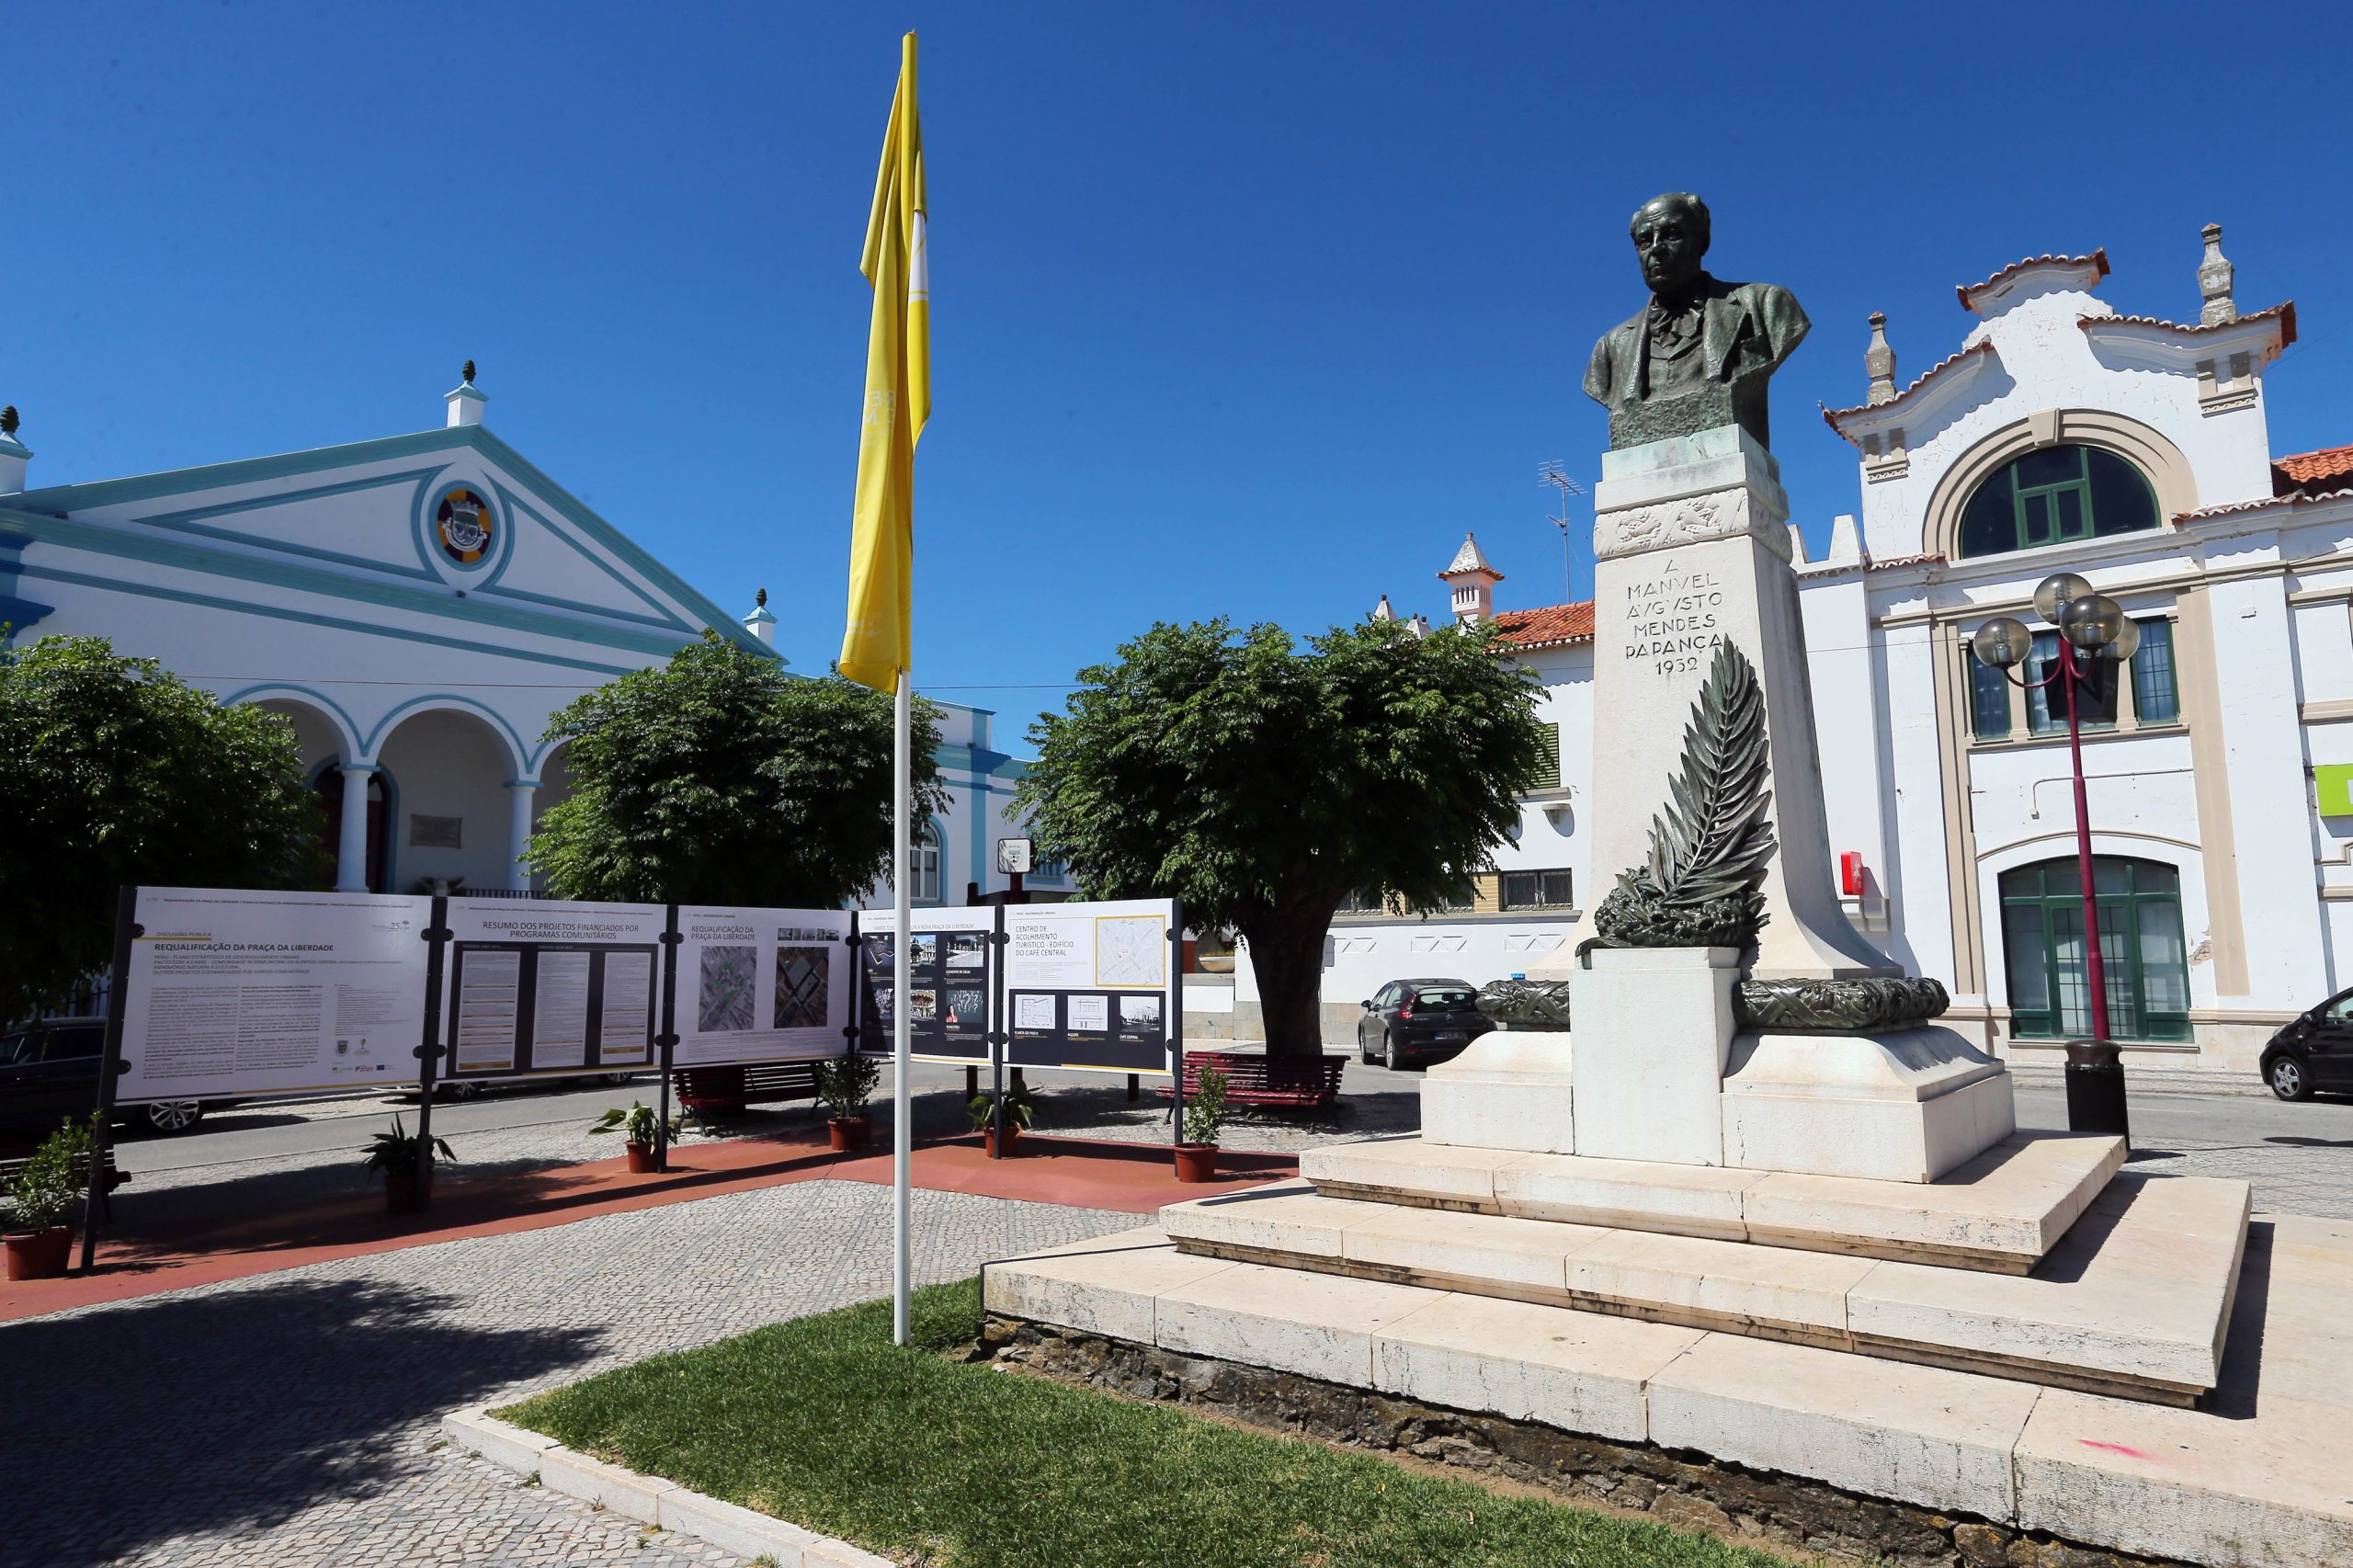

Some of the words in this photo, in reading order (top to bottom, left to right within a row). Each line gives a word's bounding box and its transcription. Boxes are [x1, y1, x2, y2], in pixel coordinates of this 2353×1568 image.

[1665, 559, 1679, 574] A
[1634, 614, 1716, 639] MENDES
[1625, 633, 1723, 660] PAPANÇA
[1655, 657, 1698, 675] 1932
[483, 921, 518, 929] RESUMO
[520, 922, 537, 930] DOS
[539, 923, 575, 931] PROJETOS
[578, 924, 624, 932] FINANCIADOS
[691, 925, 744, 934] REQUALIFICAÇÃO
[510, 930, 561, 938] PROGRAMAS
[562, 930, 617, 939] COMUNITÁRIOS
[691, 933, 711, 941] PRAÇA
[154, 943, 231, 951] REQUALIFICAÇÃO
[247, 944, 275, 952] PRAÇA
